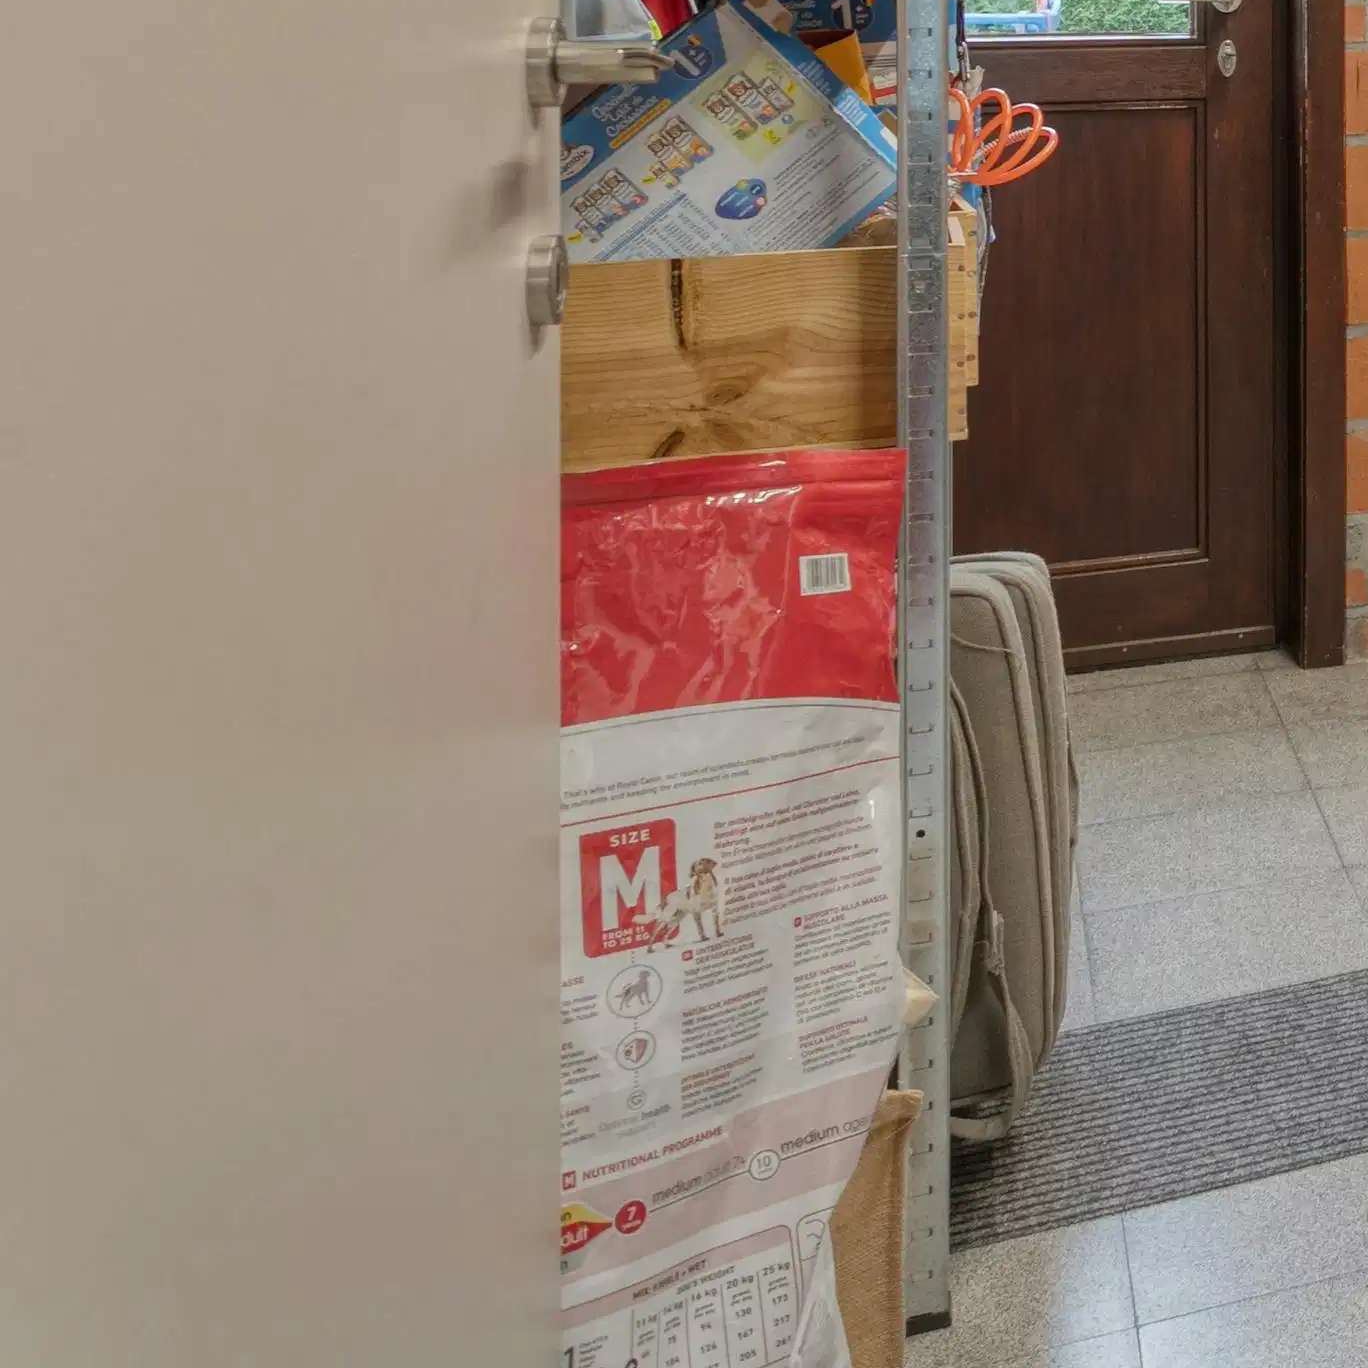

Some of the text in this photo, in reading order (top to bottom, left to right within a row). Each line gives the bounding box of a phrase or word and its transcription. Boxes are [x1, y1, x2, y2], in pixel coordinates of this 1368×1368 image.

[609, 829, 650, 848] SIZE
[600, 845, 661, 931] M
[582, 1149, 660, 1182] NUTRITIONAL
[662, 1125, 724, 1157] PROGRAMME
[780, 1124, 839, 1154] medium
[756, 1155, 772, 1170] 10
